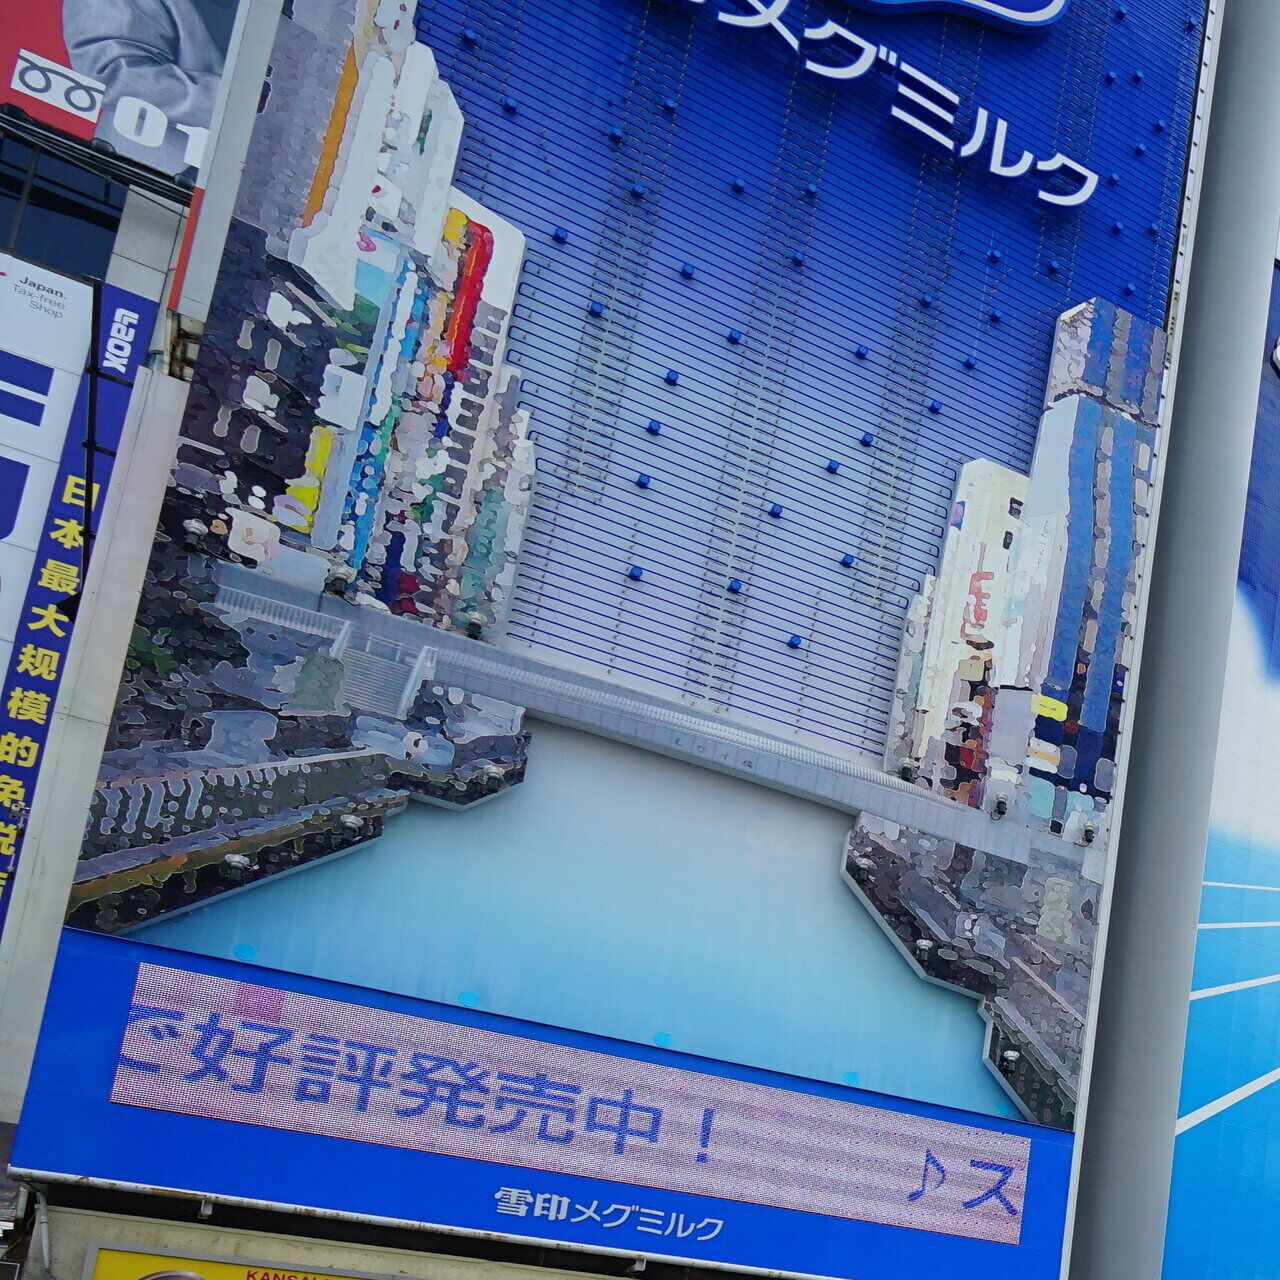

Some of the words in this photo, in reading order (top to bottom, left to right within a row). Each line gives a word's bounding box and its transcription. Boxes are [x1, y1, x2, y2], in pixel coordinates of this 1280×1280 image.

[12, 283, 66, 309] Tax-free
[19, 277, 67, 299] Japan.
[29, 300, 63, 319] Shop
[493, 1186, 725, 1242] 雪印メグミルク
